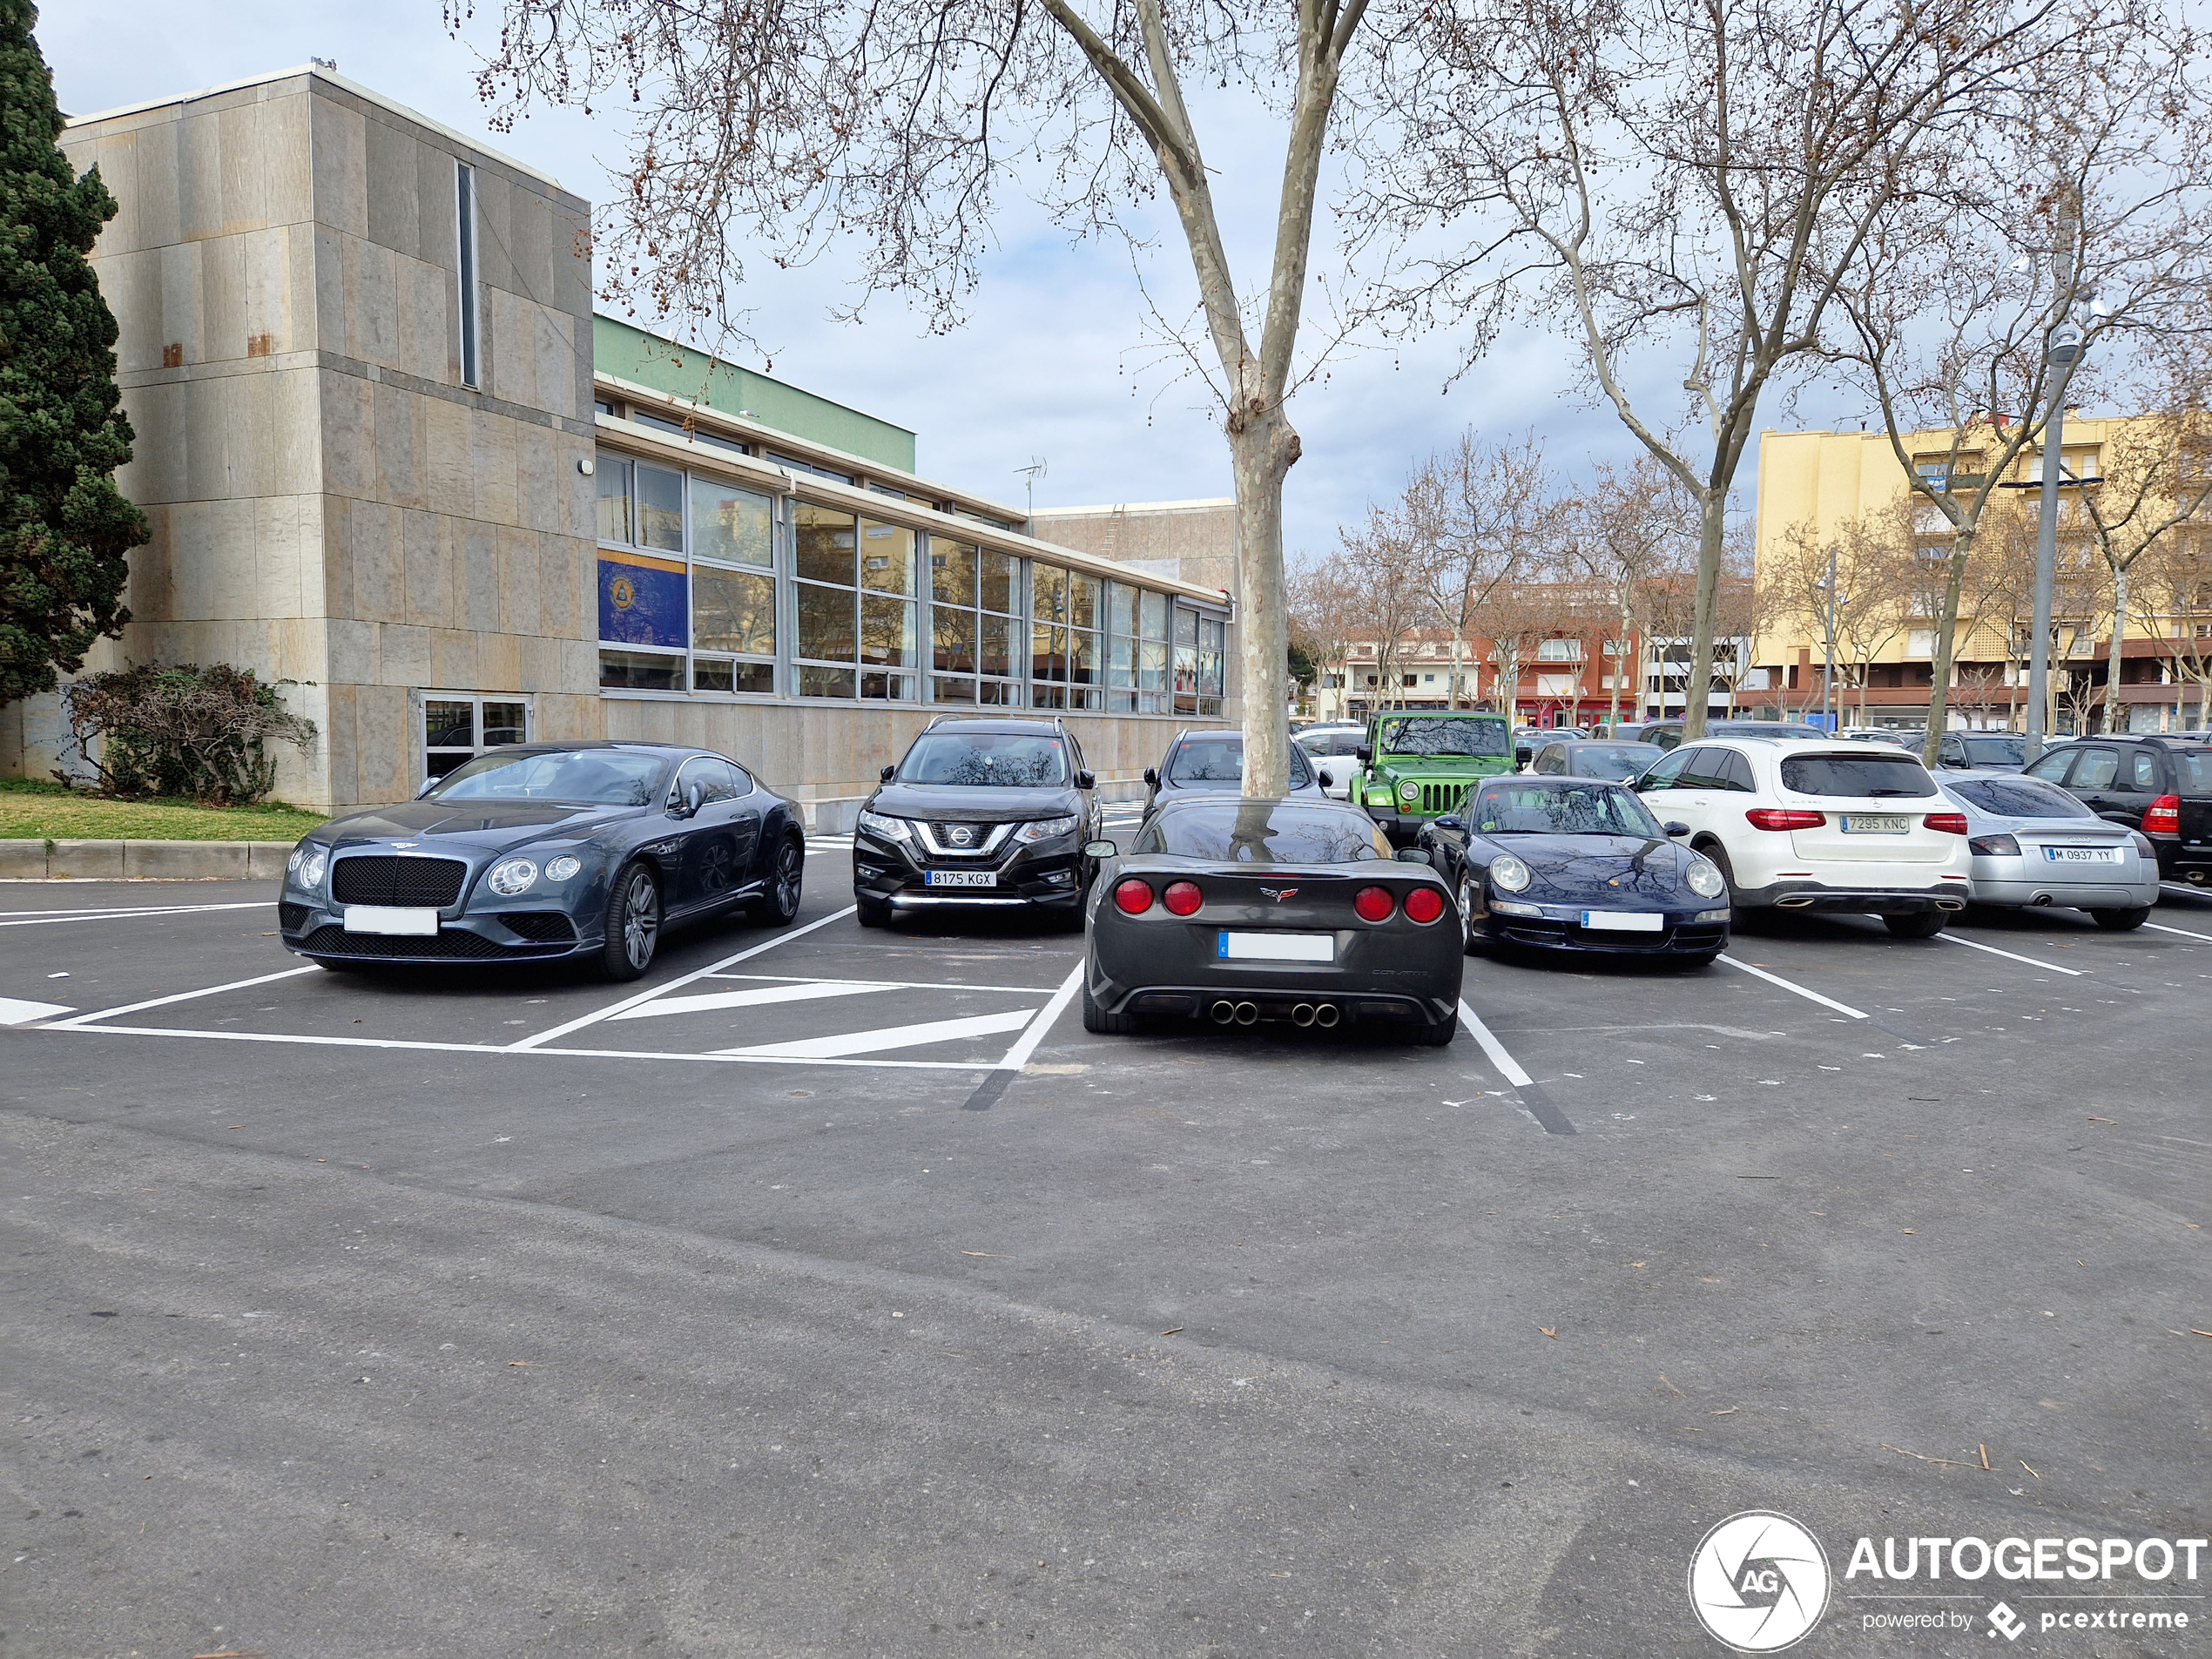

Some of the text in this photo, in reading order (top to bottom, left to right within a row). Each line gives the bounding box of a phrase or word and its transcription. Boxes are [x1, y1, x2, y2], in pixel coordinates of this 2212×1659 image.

[1850, 818, 1906, 829] 7295 KNC
[2055, 851, 2109, 860] M 0937 YY
[934, 873, 991, 885] 8175 KGX
